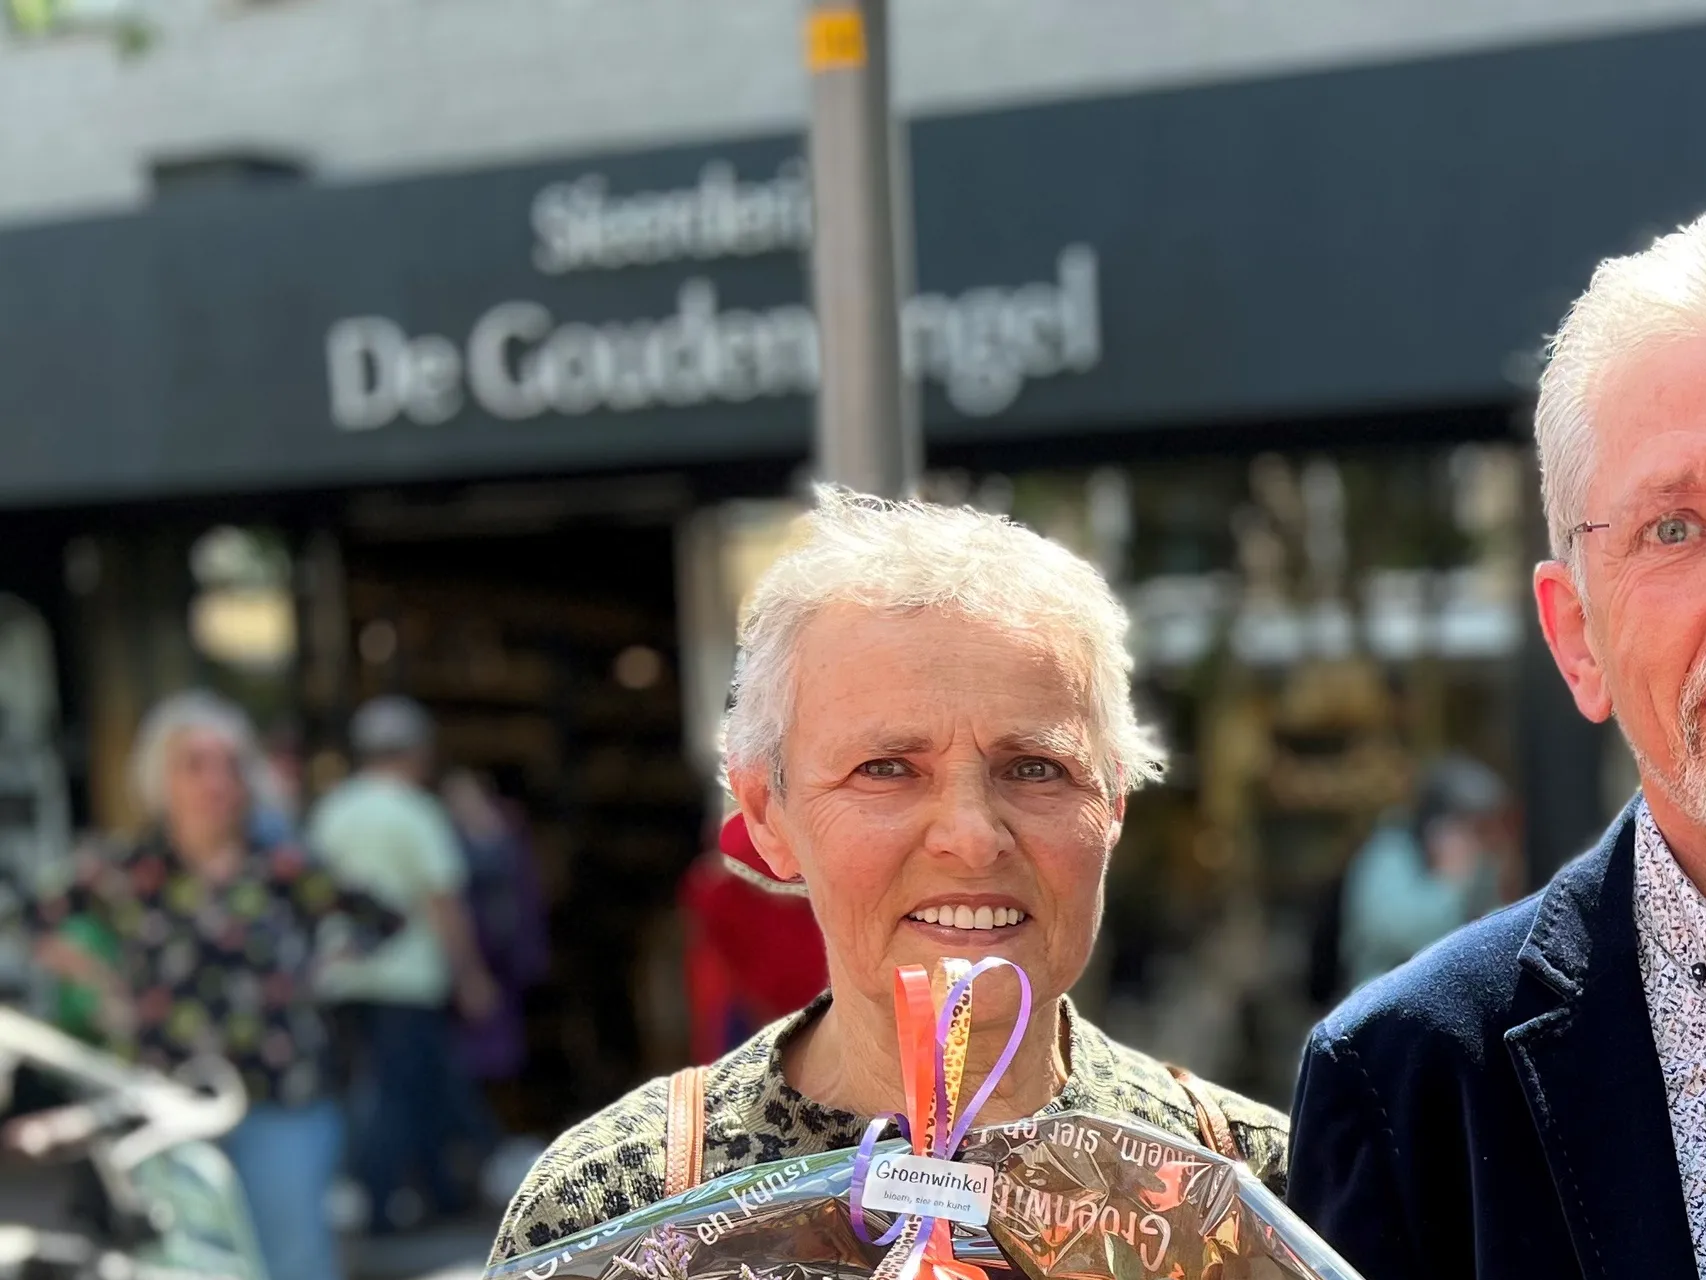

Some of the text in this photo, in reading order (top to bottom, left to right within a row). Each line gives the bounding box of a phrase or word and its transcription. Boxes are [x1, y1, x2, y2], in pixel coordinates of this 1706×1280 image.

[326, 243, 1101, 432] De Gouden ngel
[1048, 1122, 1100, 1158] sier
[876, 1160, 988, 1194] Groenwinkel
[933, 1199, 945, 1207] en
[947, 1200, 972, 1212] kunst
[696, 1209, 736, 1247] en
